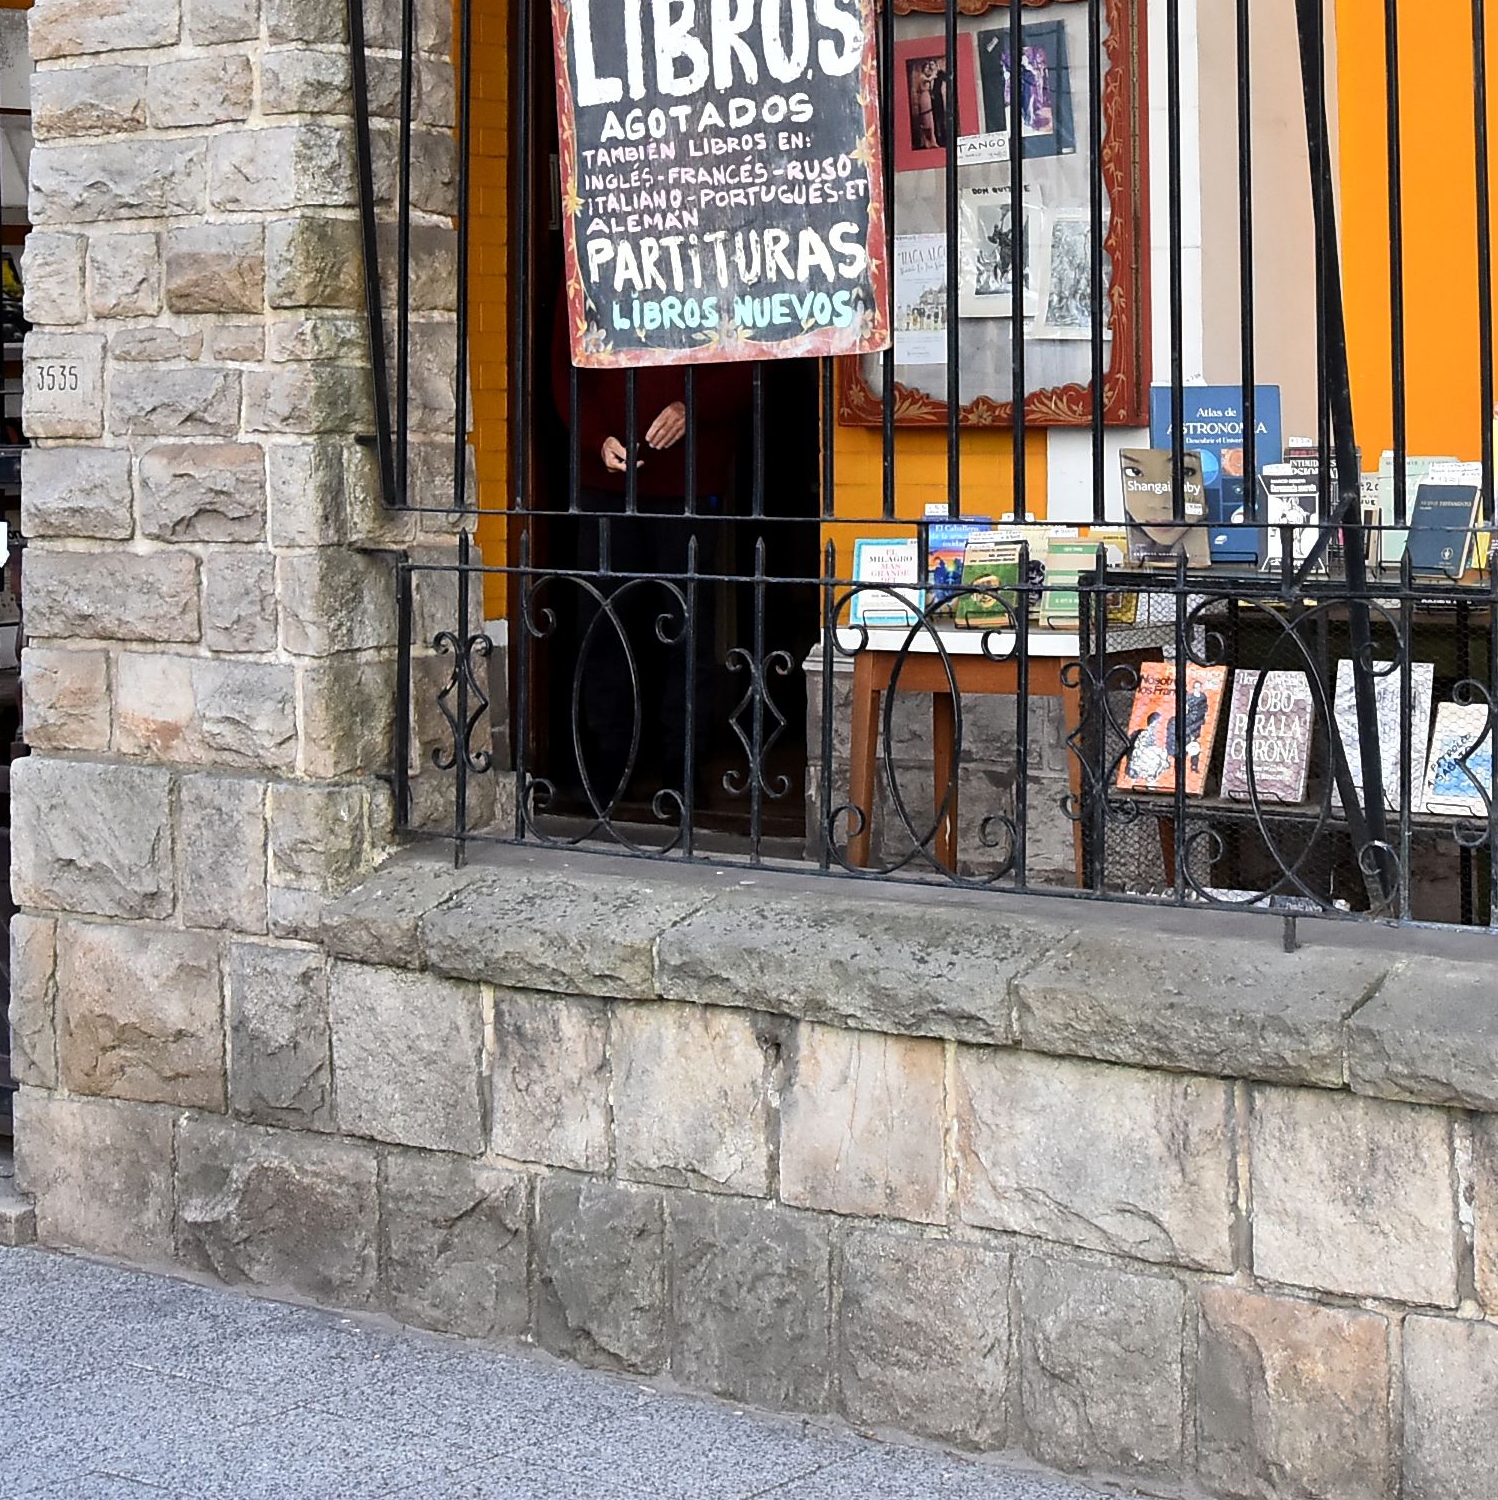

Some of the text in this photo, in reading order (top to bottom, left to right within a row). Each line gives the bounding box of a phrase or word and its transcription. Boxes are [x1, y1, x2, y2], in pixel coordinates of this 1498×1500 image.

[601, 93, 813, 142] AGOTADOS
[583, 139, 675, 168] TAMBIÉN
[689, 133, 766, 157] LIBROS
[957, 139, 1005, 153] TANGO
[587, 209, 698, 235] ALEMÁN
[735, 290, 852, 330] NUEVOS
[37, 366, 79, 391] 3535
[1196, 408, 1237, 417] Atlas de
[1167, 422, 1268, 434] STRONOA
[1128, 480, 1172, 494] Shangai
